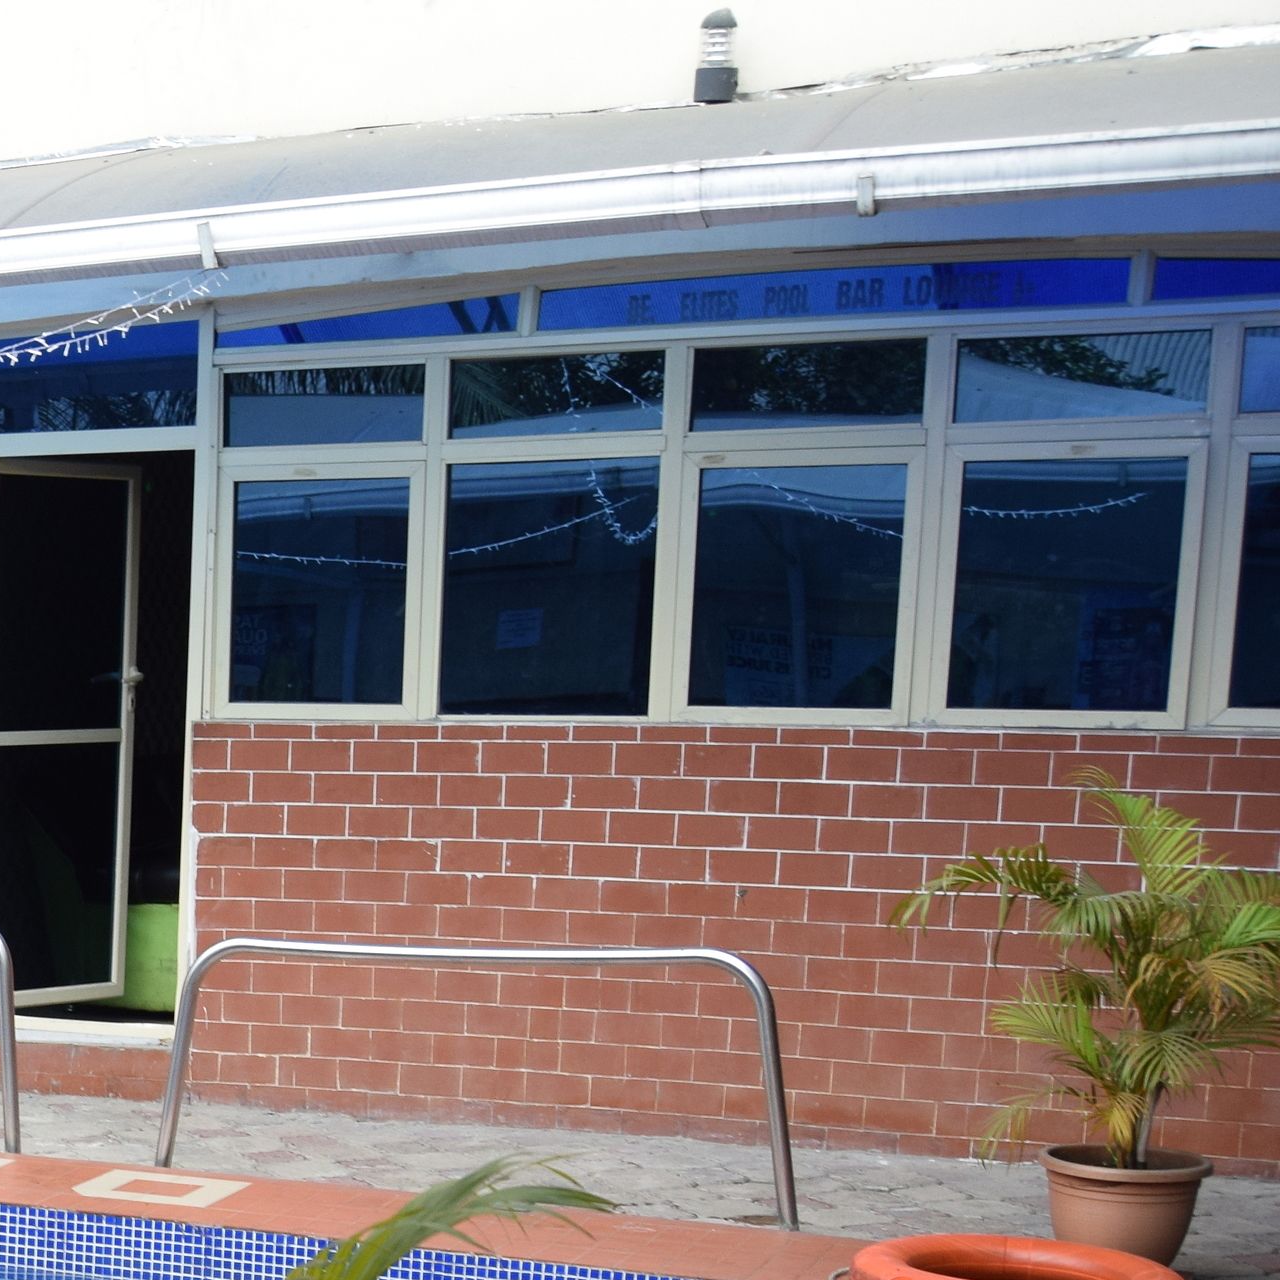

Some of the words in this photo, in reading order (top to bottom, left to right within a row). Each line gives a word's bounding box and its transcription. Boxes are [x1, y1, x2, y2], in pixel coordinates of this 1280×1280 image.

[680, 289, 739, 321] ELITES
[764, 284, 810, 317] POOL
[836, 277, 884, 309] BAR
